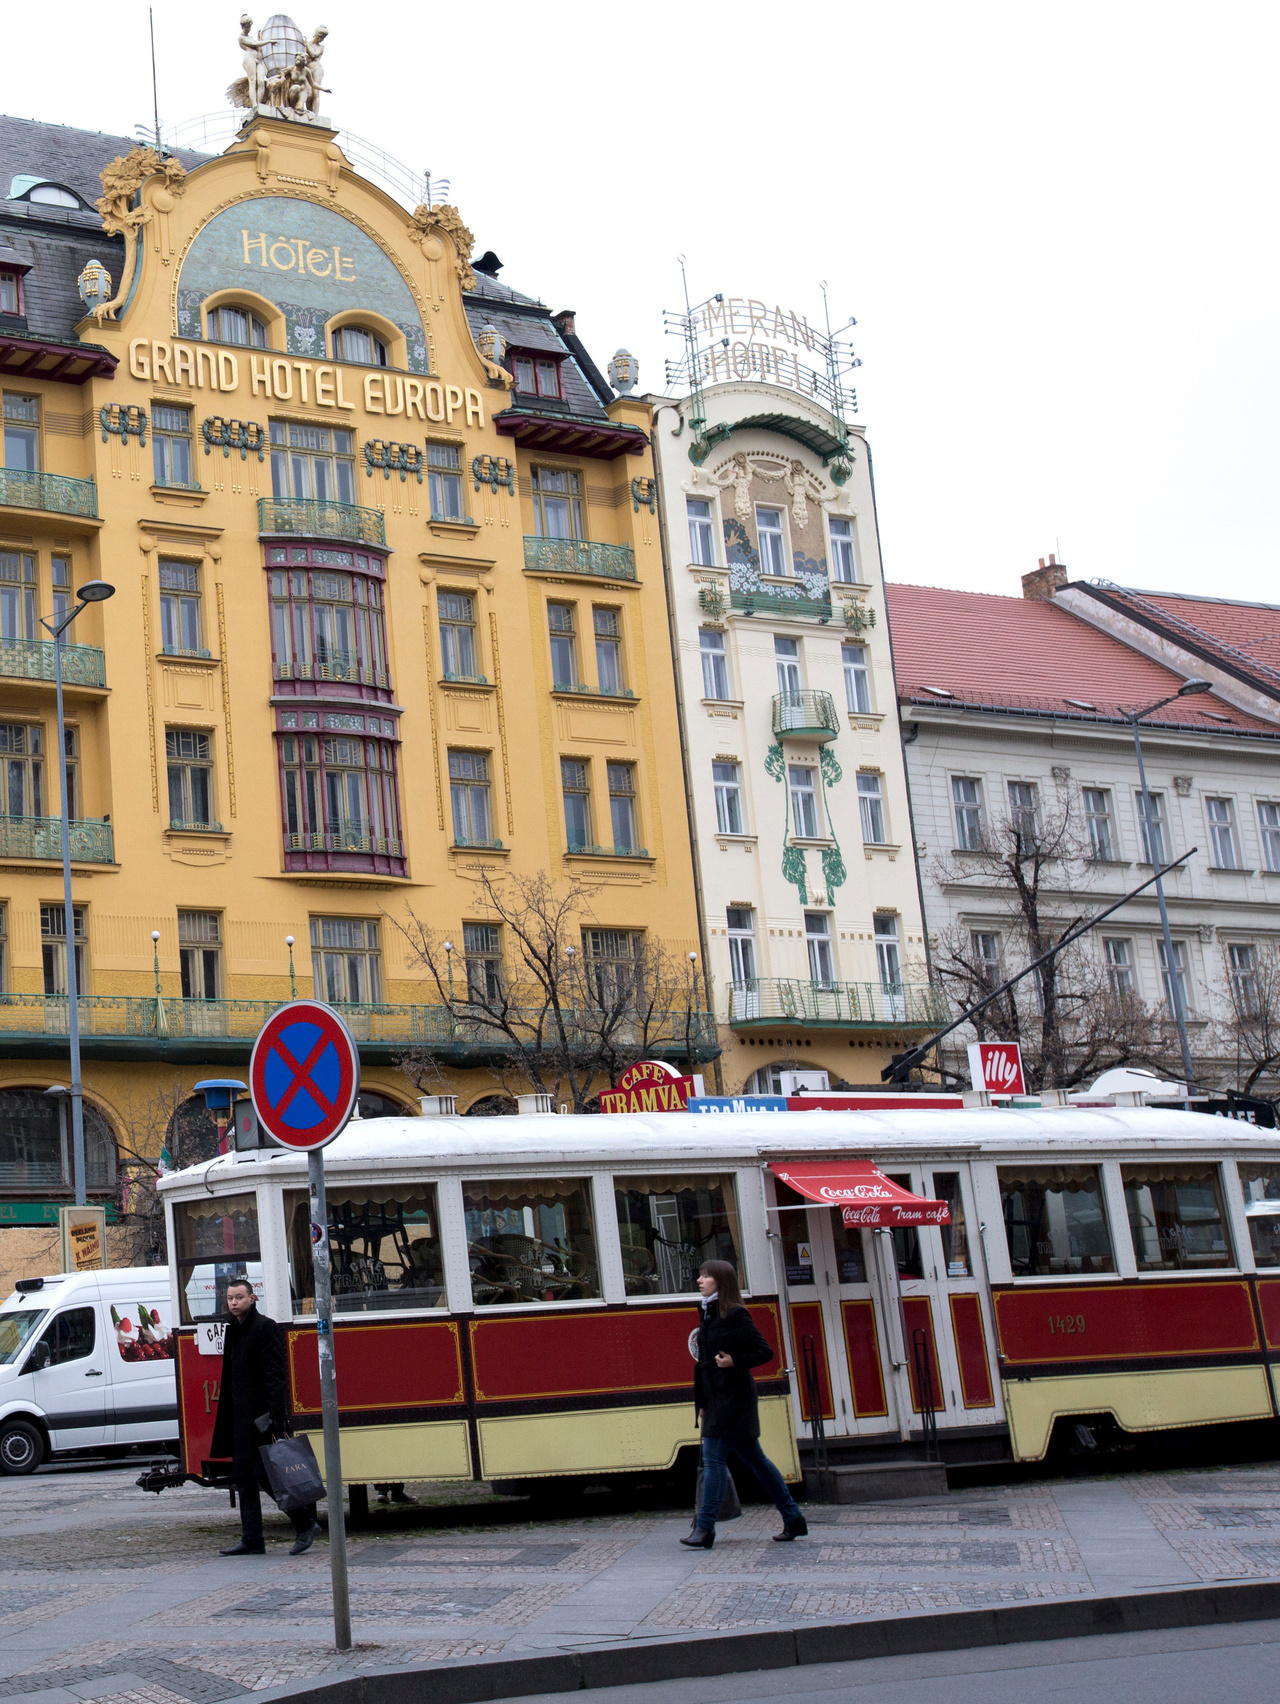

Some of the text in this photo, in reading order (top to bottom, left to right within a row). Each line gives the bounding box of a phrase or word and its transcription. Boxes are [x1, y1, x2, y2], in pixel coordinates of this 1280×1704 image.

[706, 298, 812, 352] MERAN
[709, 341, 814, 397] HOTEL
[129, 338, 486, 428] GRAND HOTEL EUROPA
[621, 1064, 666, 1091] CAFE
[984, 1050, 1018, 1089] illy
[601, 1081, 694, 1114] TRAMVAJ
[820, 1185, 893, 1199] Coca-Cola
[842, 1206, 881, 1223] Coca-Cola
[892, 1206, 949, 1222] Tram café
[207, 1323, 225, 1342] CAF
[1048, 1315, 1086, 1335] 1429
[203, 1379, 220, 1413] 14
[285, 1463, 307, 1474] ZARA
